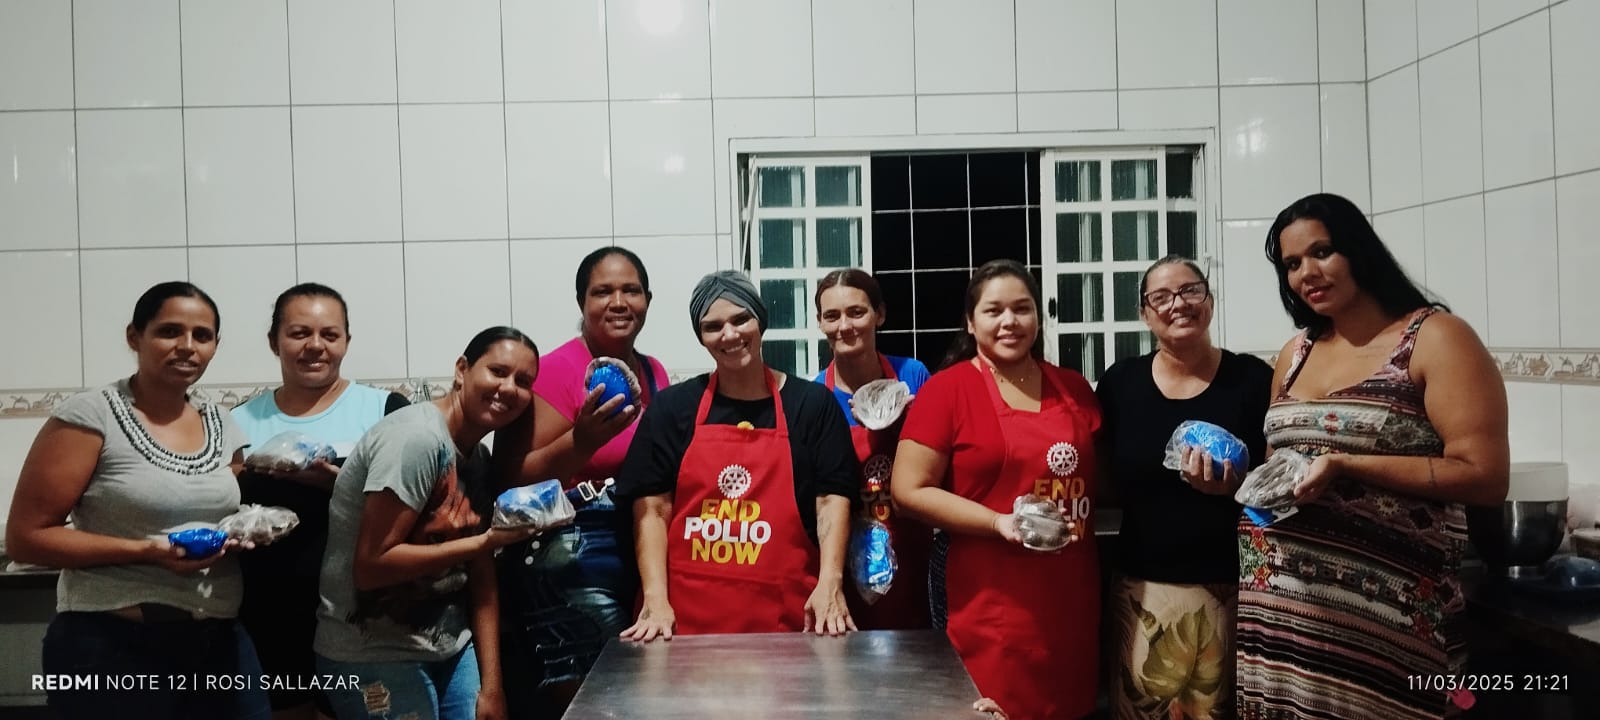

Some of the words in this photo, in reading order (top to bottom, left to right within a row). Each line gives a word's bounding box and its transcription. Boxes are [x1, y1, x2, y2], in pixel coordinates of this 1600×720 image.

[1033, 478, 1086, 501] END
[699, 499, 761, 522] END
[1057, 496, 1090, 521] LIO
[683, 516, 772, 545] POLIO
[691, 538, 763, 565] NOW
